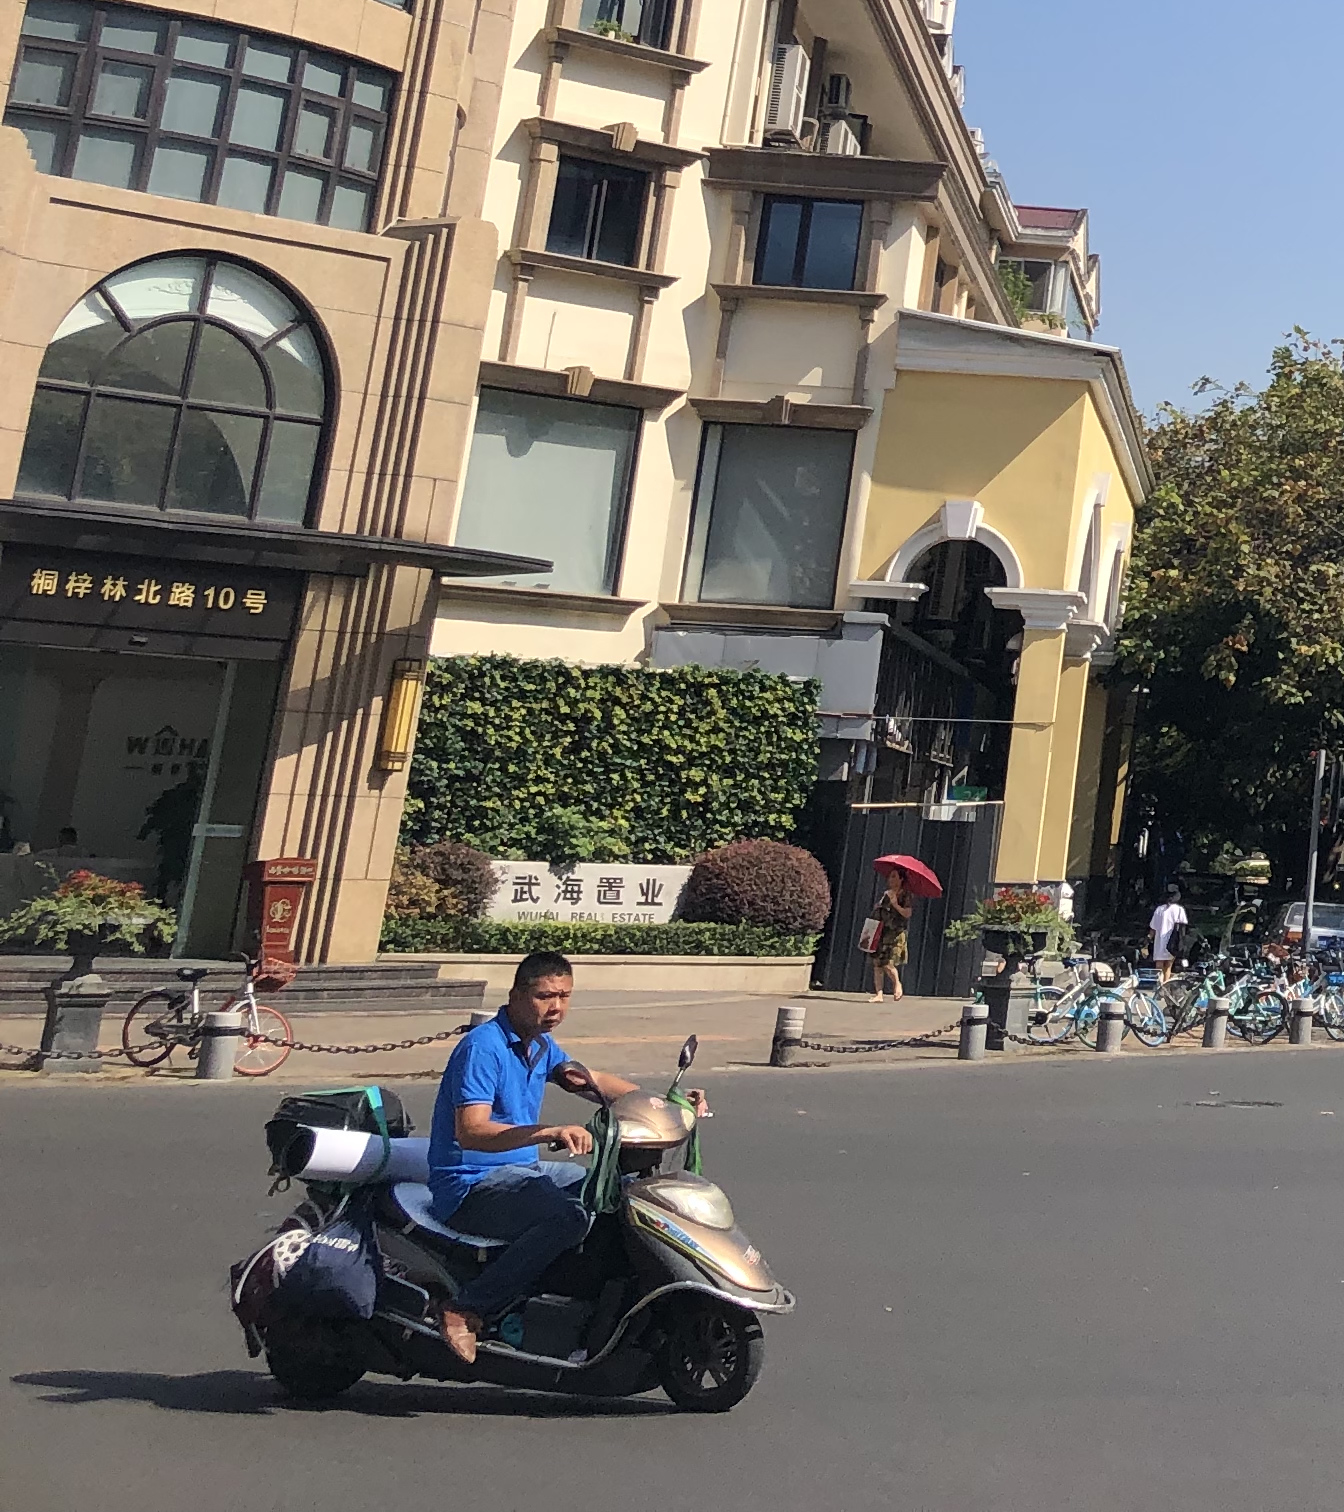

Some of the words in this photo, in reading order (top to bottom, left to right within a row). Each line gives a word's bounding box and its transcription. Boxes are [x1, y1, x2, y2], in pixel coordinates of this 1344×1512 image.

[31, 568, 268, 614] 桐梓林北路10号
[511, 874, 664, 906] 武海置业
[517, 911, 559, 922] WUHAI
[570, 912, 600, 922] REAL
[611, 913, 655, 924] ESTATE
